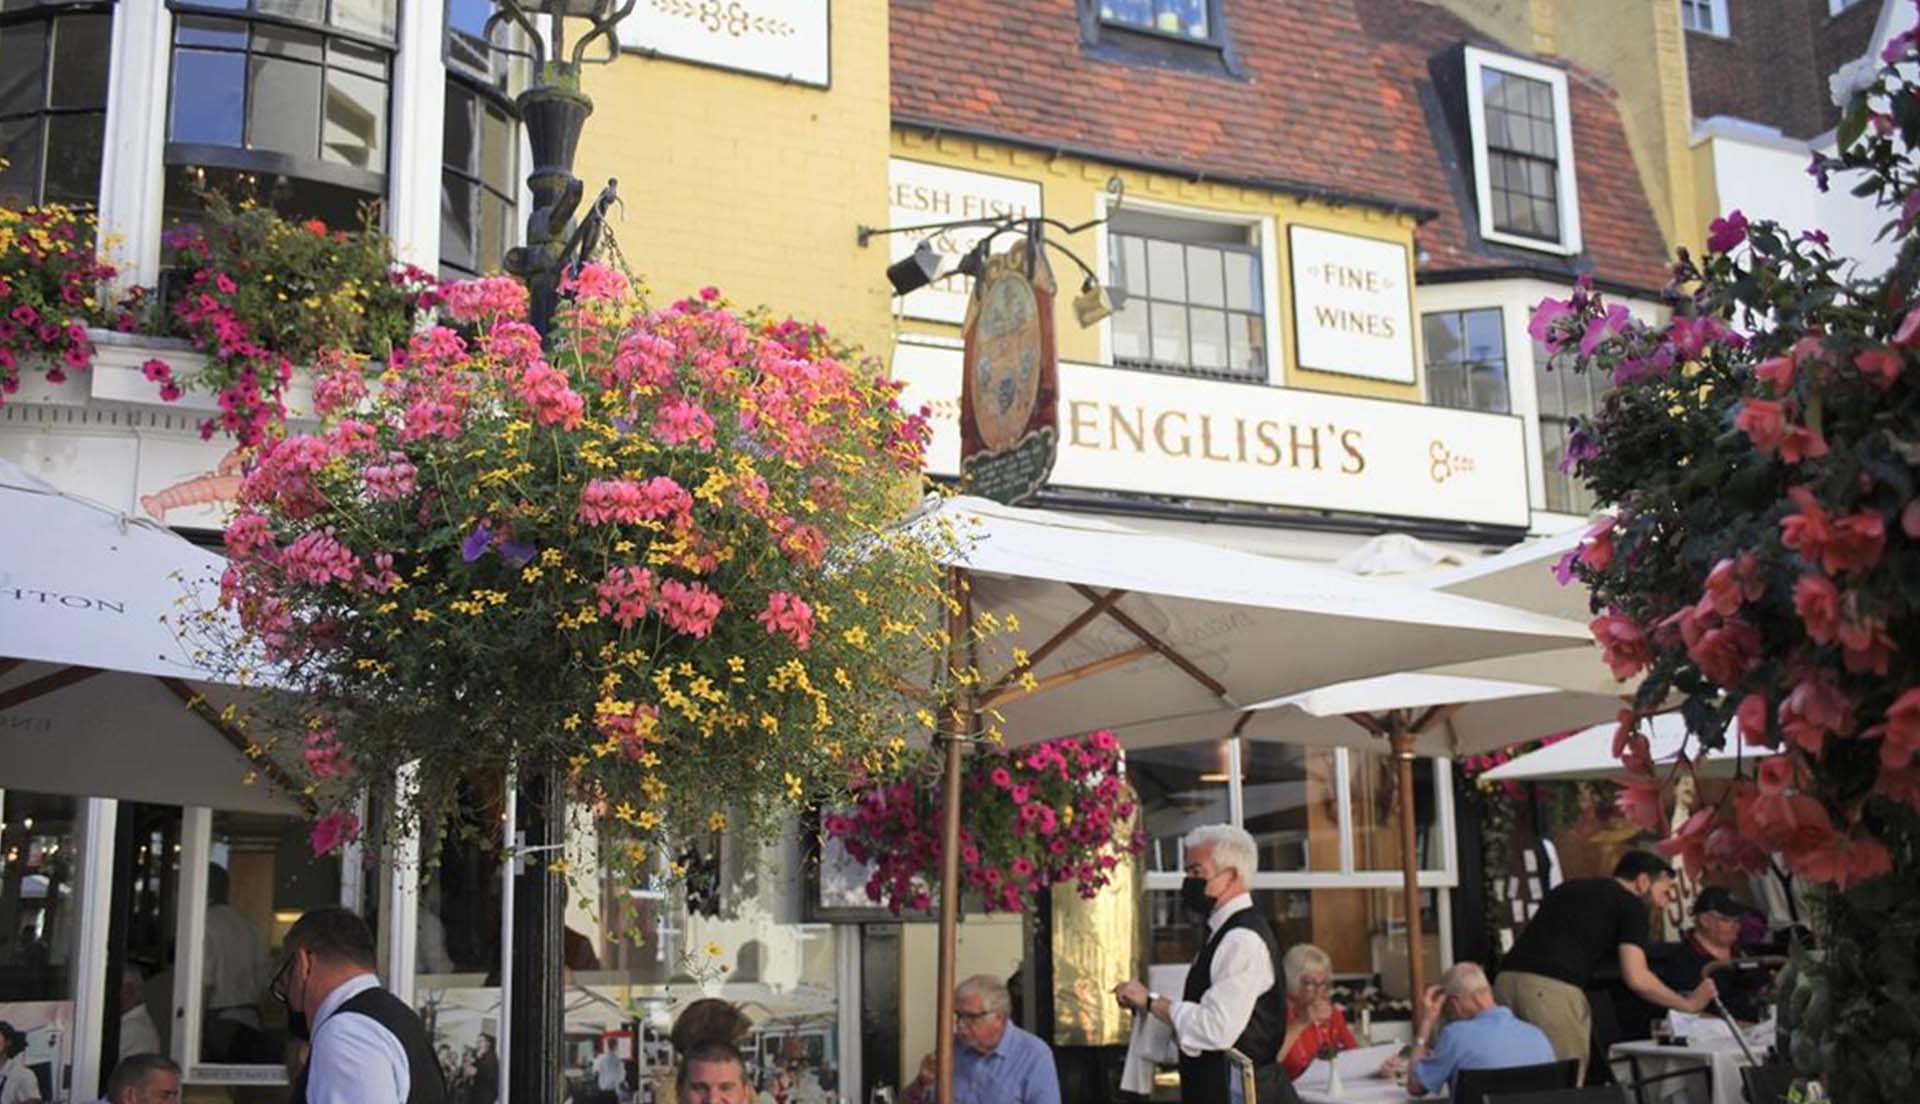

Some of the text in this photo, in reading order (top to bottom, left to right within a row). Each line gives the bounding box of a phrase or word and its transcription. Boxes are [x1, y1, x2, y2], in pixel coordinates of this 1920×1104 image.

[963, 194, 1028, 221] FISH
[1323, 262, 1379, 293] FINE
[1314, 304, 1395, 339] WINES
[1068, 399, 1366, 475] ENGLISH'S
